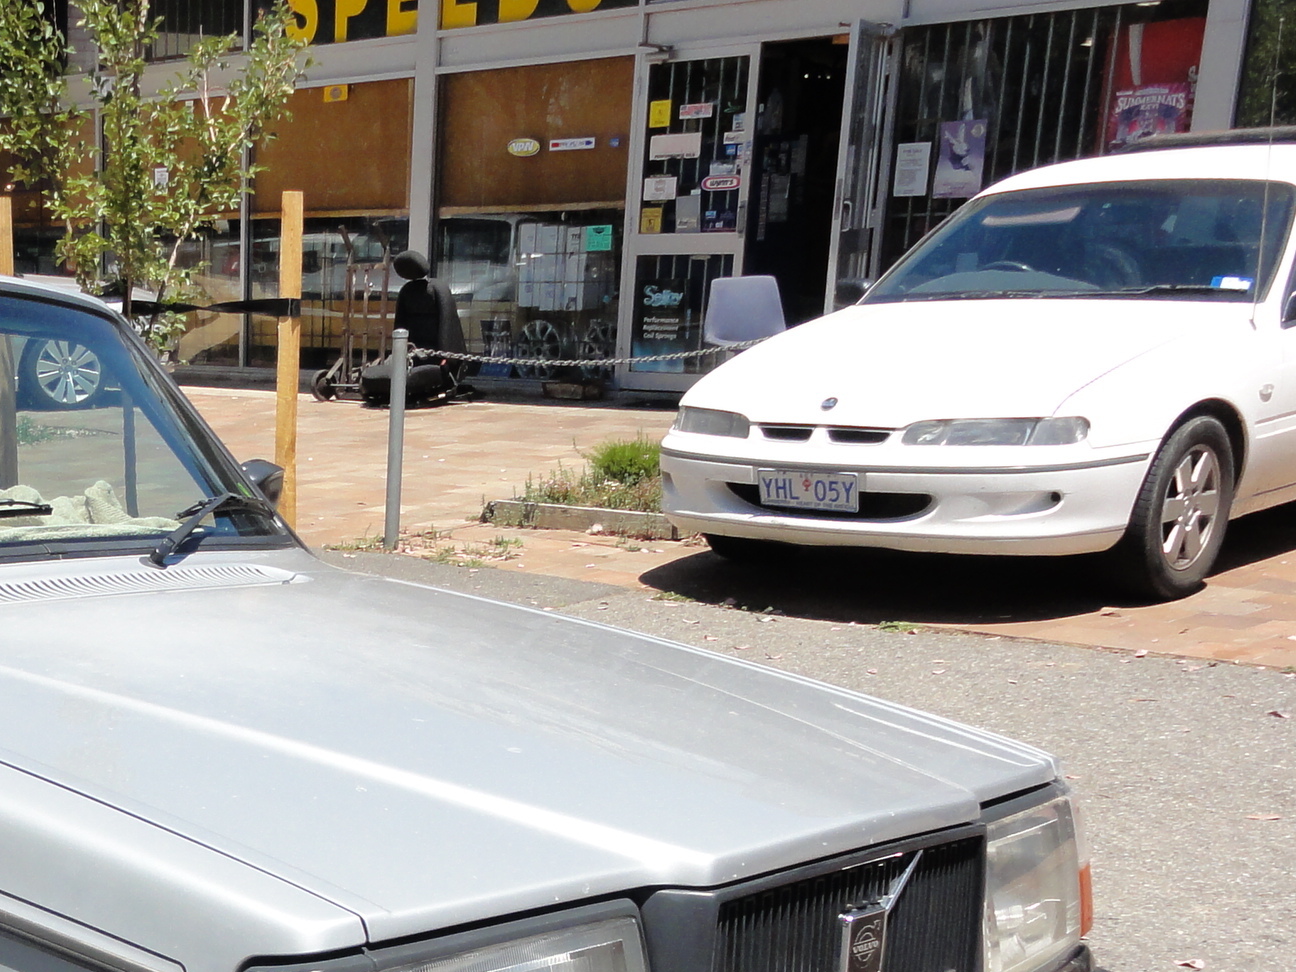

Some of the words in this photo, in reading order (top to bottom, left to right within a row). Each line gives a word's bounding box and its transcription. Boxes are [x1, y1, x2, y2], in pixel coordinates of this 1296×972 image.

[762, 477, 800, 500] YHL
[814, 480, 855, 504] 05Y
[851, 938, 880, 955] VOLVO
